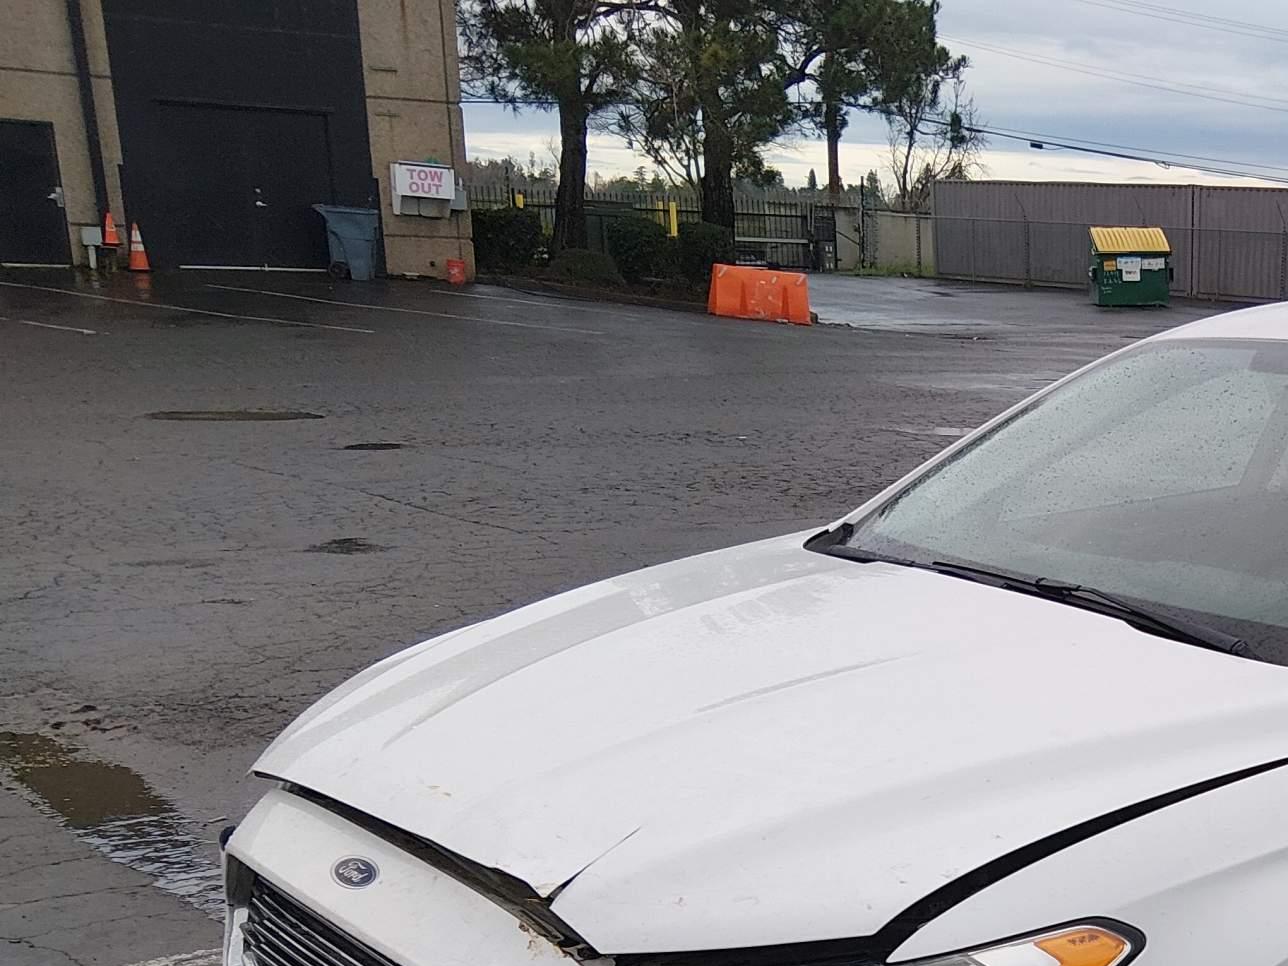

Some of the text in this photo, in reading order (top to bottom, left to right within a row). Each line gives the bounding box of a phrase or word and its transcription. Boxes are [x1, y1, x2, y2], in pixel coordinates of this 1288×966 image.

[406, 168, 443, 183] TOW
[409, 182, 443, 195] OUT
[338, 860, 369, 883] Ford
